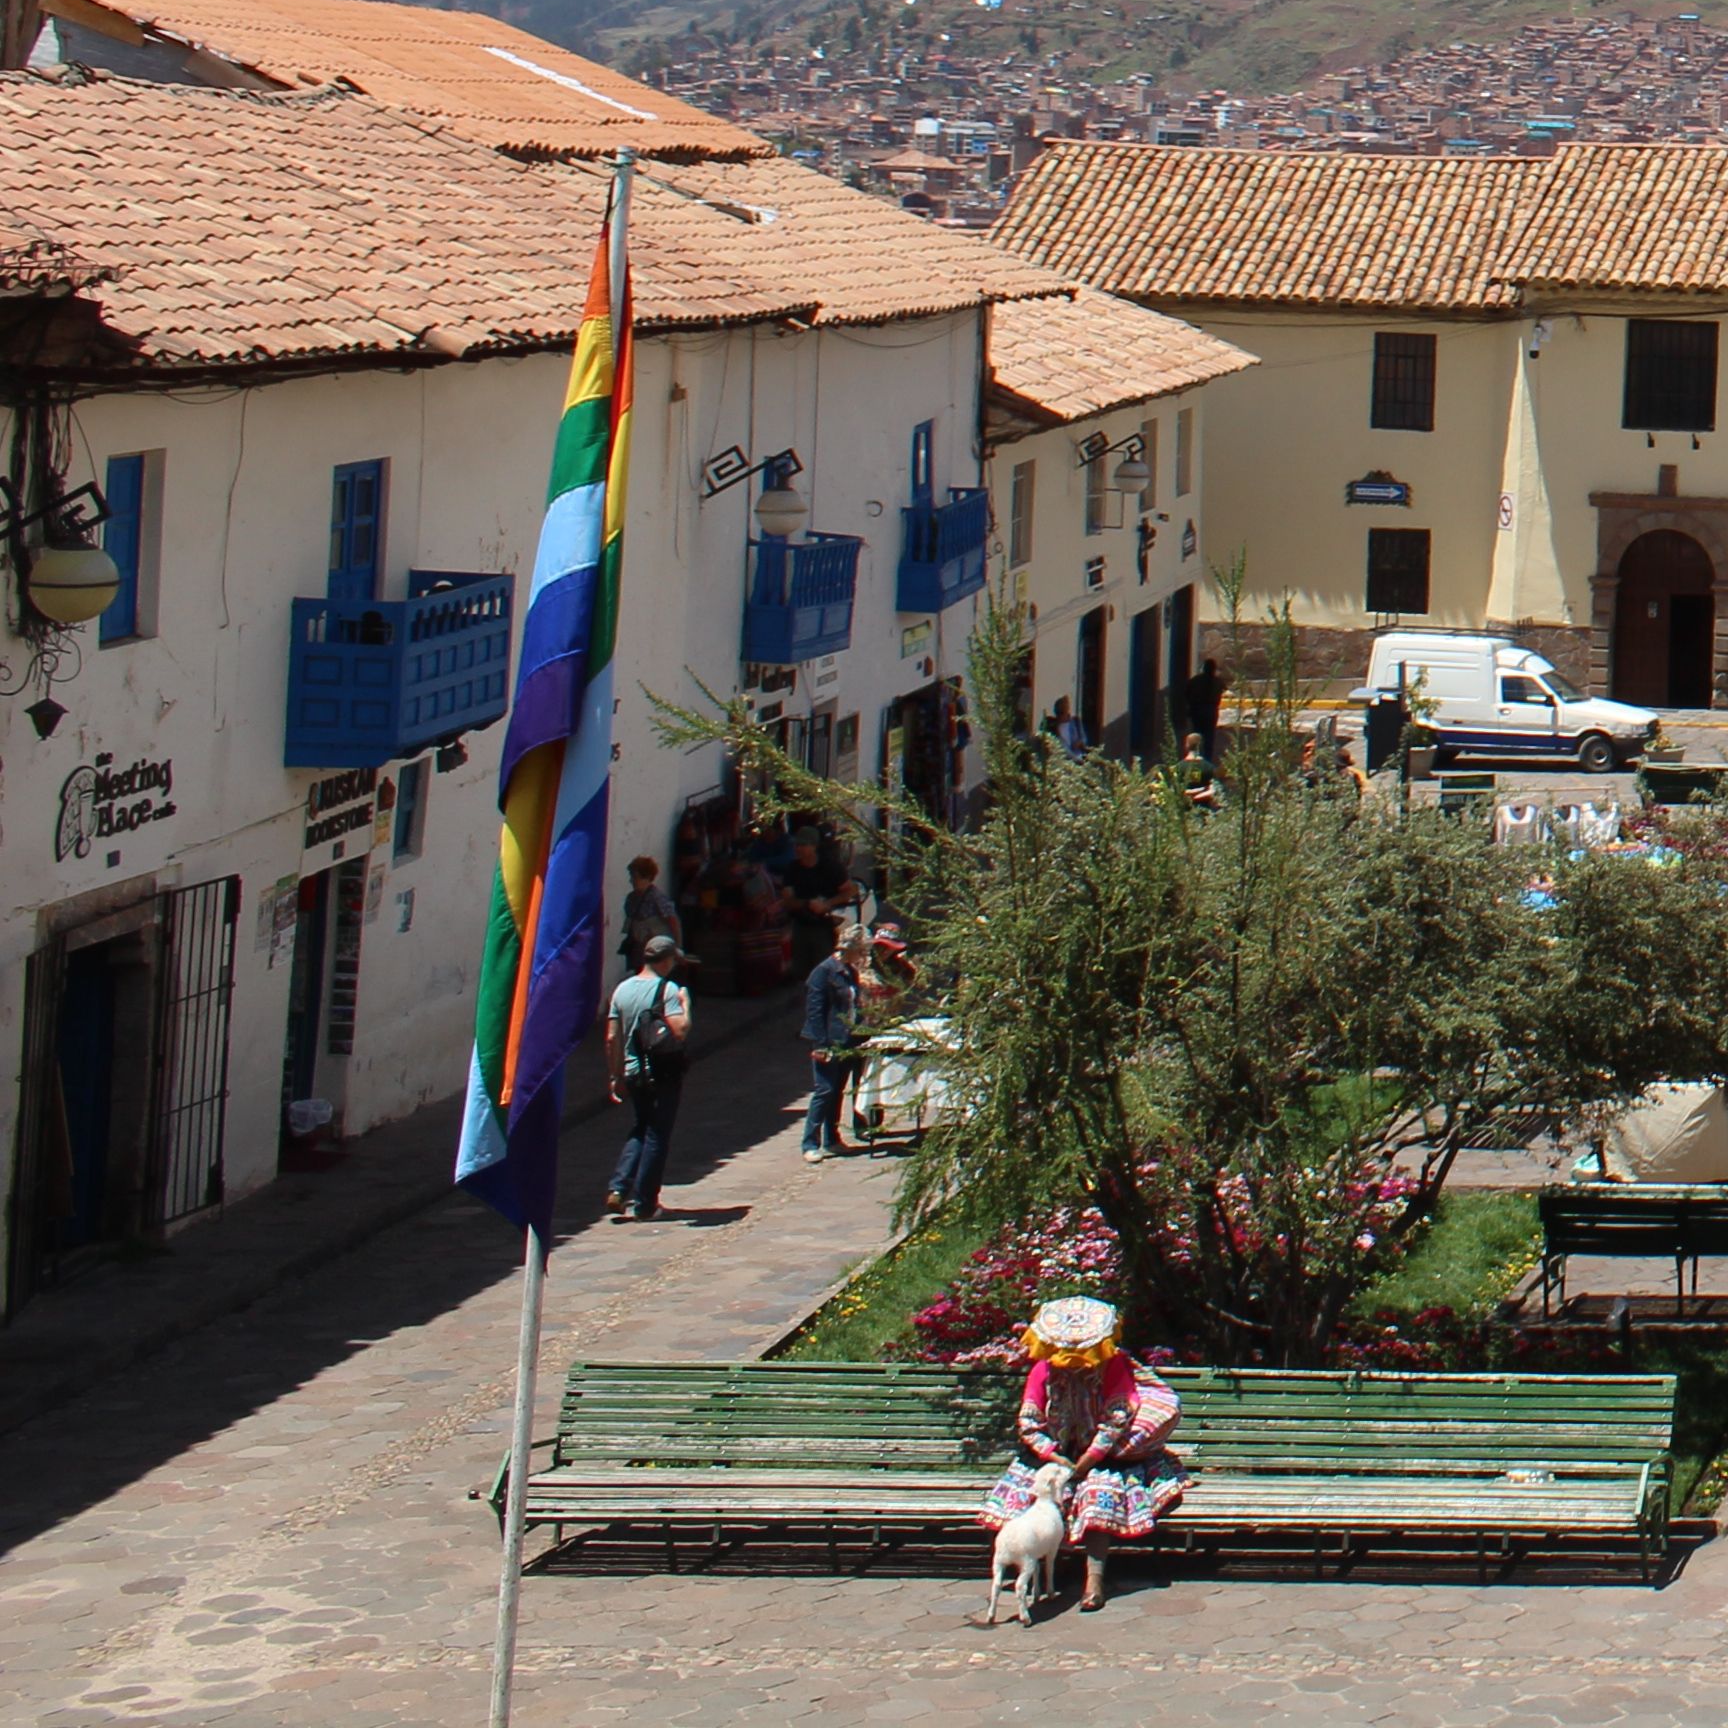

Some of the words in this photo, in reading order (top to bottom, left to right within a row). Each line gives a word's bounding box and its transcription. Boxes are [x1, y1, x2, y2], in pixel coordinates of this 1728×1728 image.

[95, 758, 172, 805] Meeting
[96, 798, 152, 837] Place
[305, 801, 374, 849] BOOKSTORE
